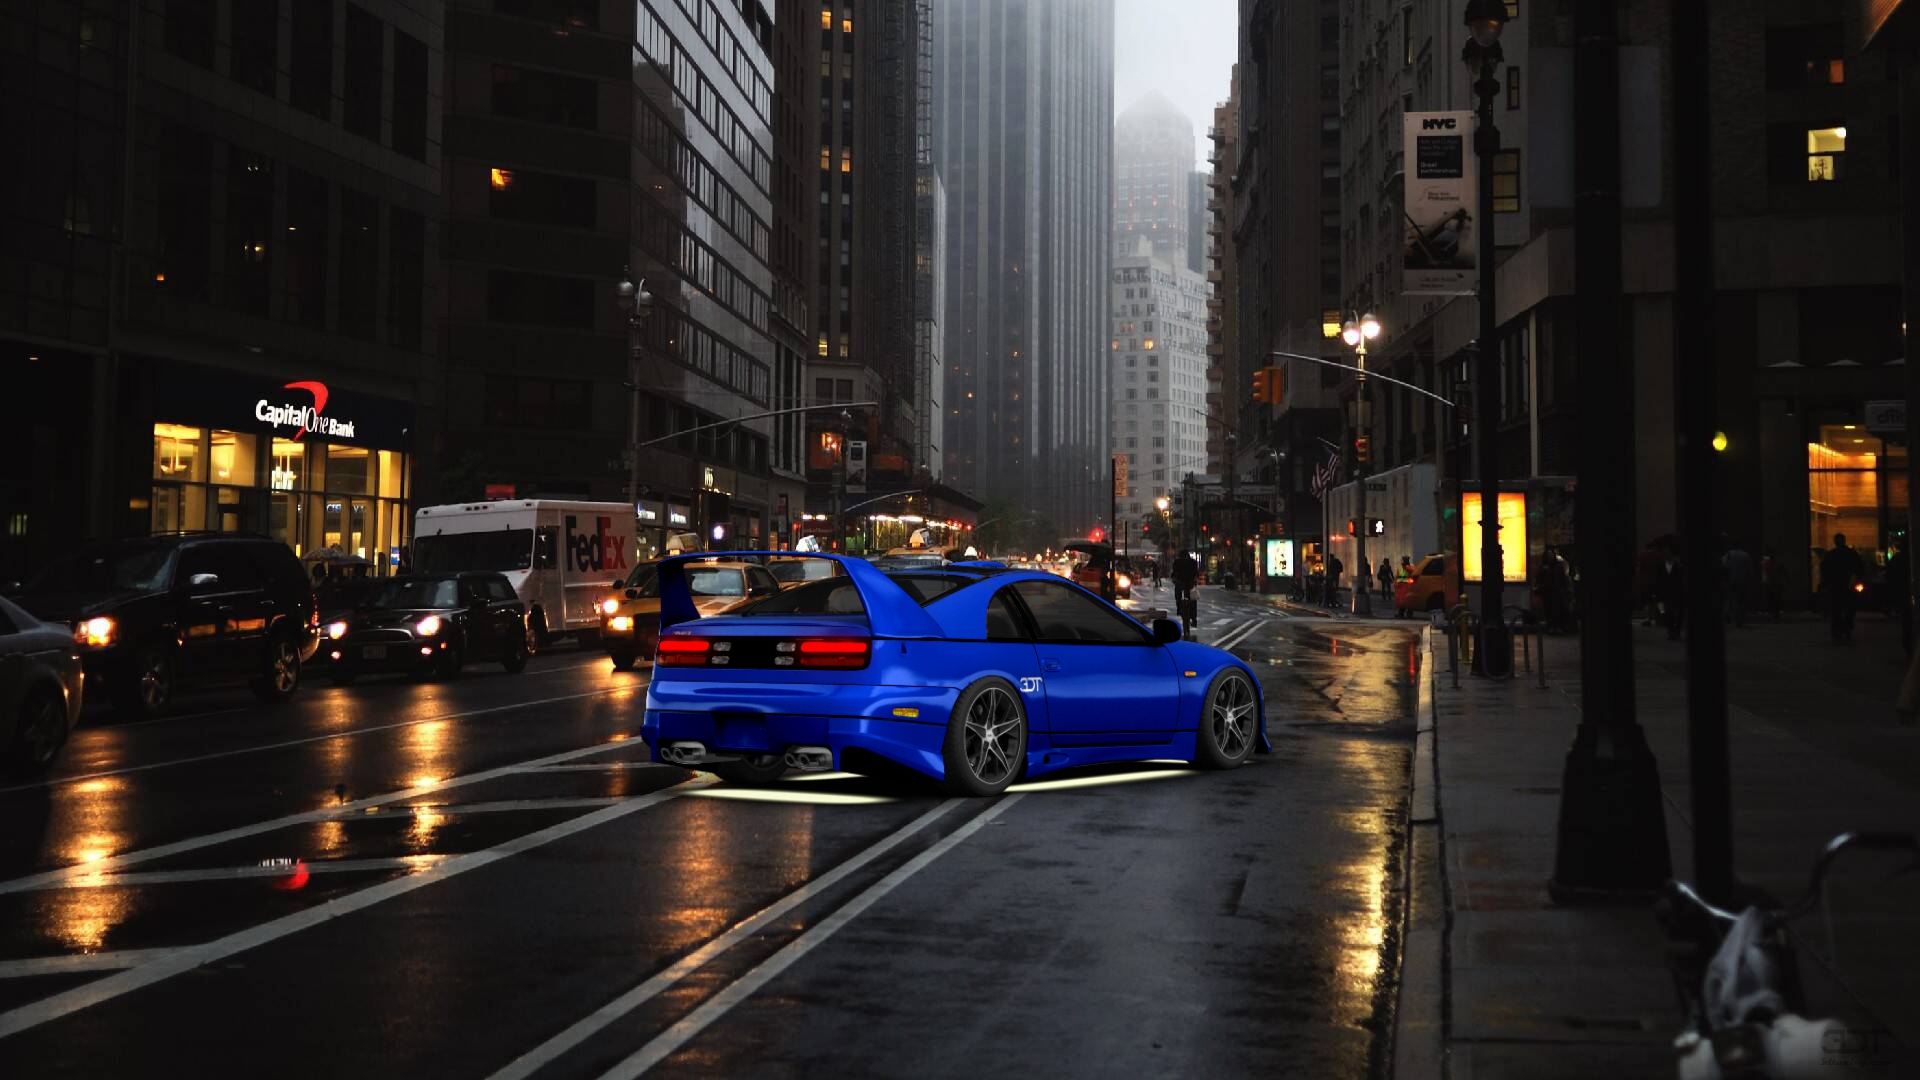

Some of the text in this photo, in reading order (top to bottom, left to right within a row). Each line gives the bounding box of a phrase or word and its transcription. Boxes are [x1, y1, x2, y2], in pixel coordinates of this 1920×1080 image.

[1423, 118, 1456, 129] NYC
[328, 418, 355, 438] Bank
[566, 515, 627, 572] FedEx
[1020, 676, 1043, 692] 3DT
